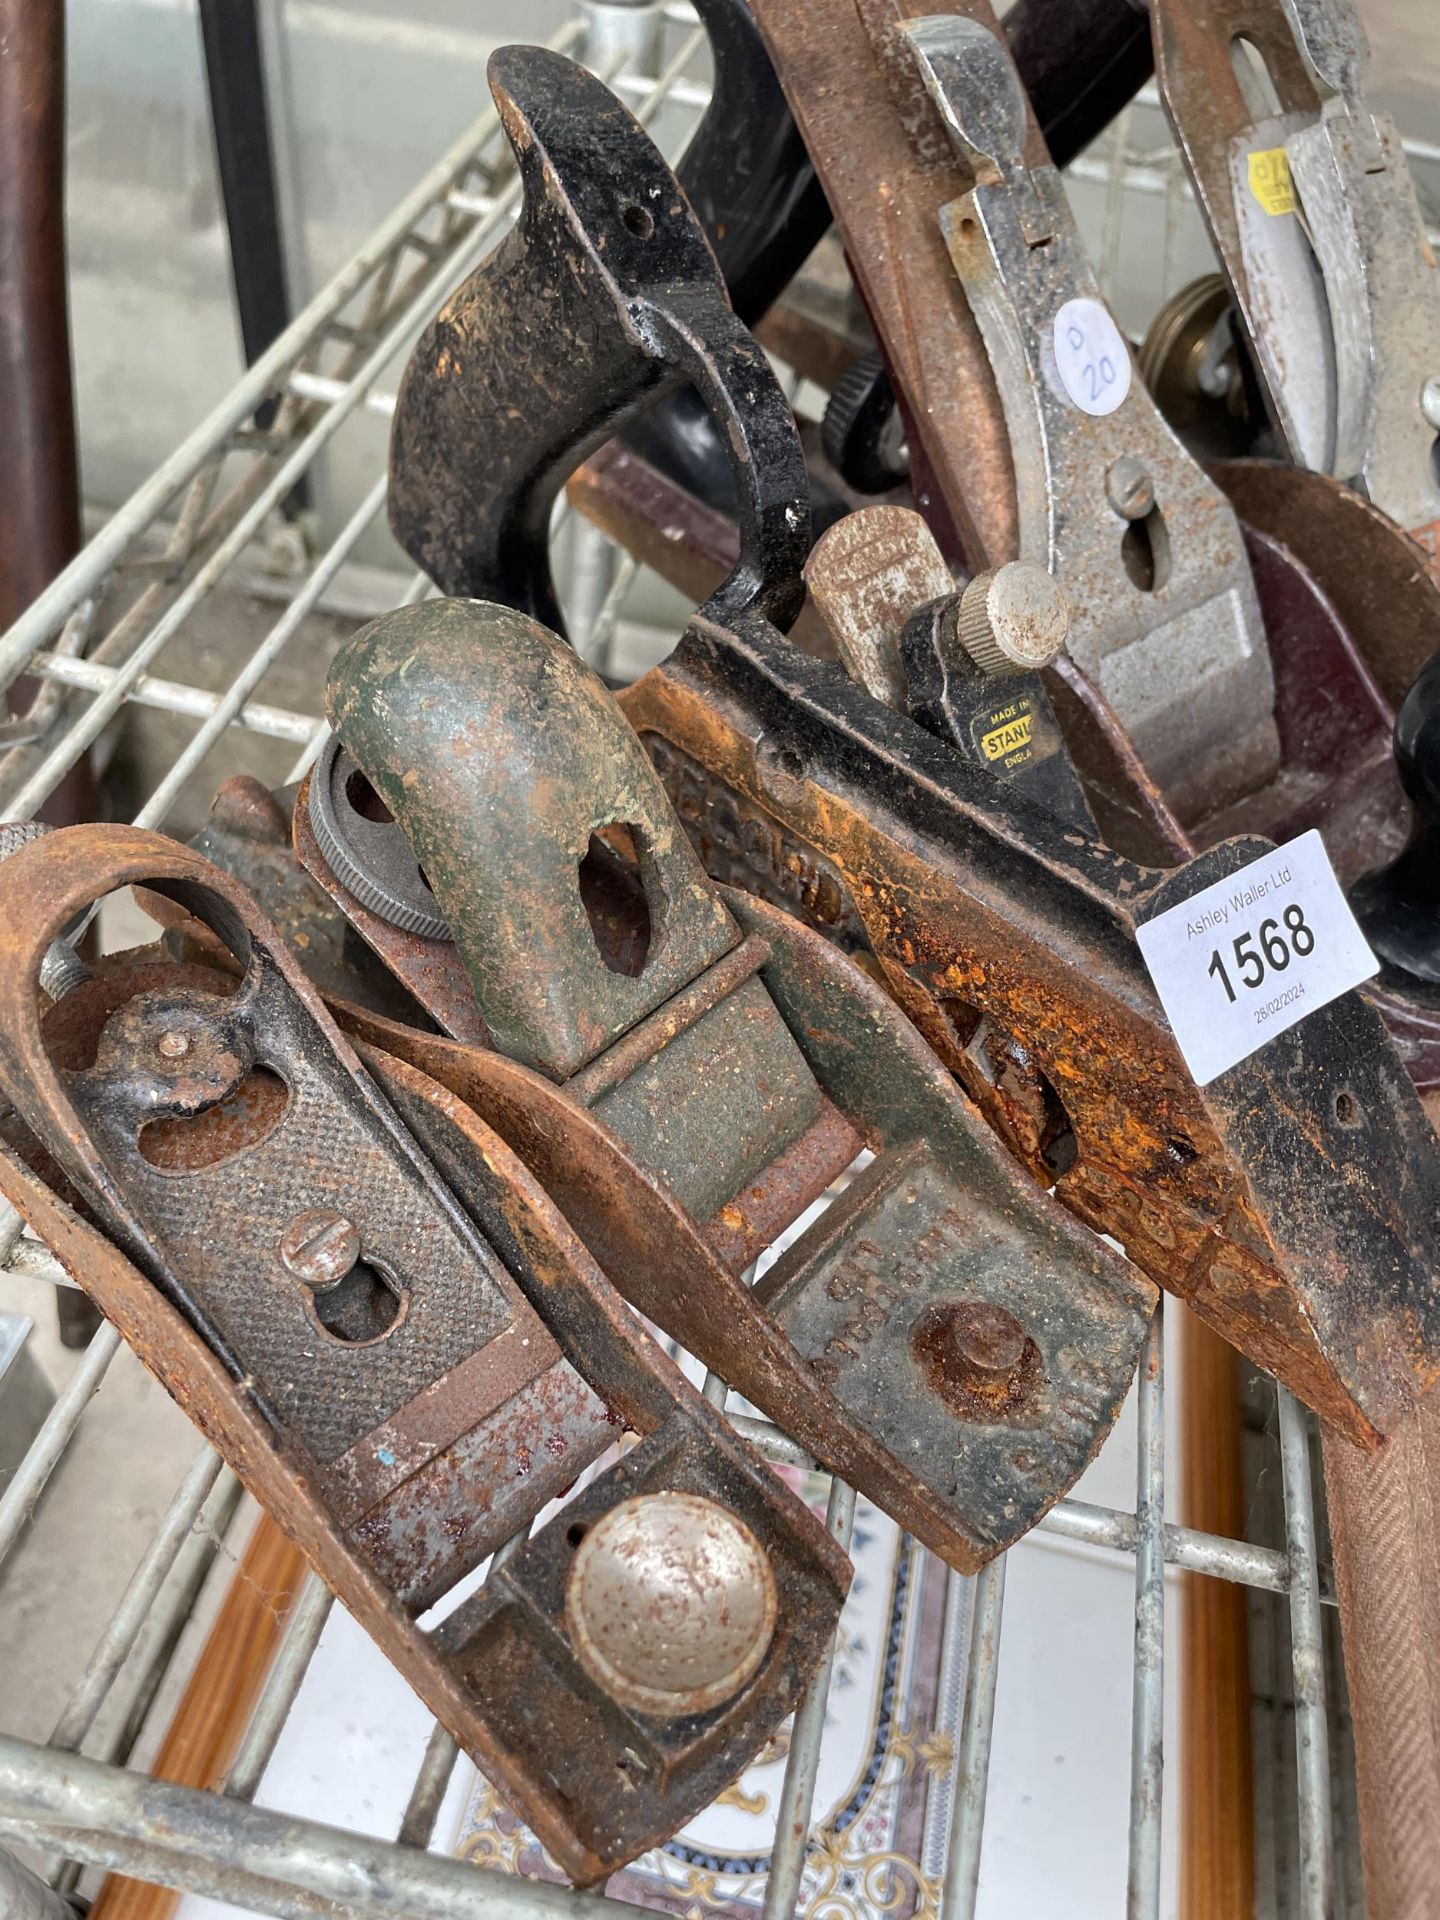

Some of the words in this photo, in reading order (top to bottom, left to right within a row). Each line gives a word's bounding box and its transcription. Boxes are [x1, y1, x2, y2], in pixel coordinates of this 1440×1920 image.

[1082, 355, 1117, 402] 20
[990, 704, 1017, 725] MADE
[987, 721, 1031, 754] STANL
[1004, 749, 1031, 769] ENGLA
[1185, 902, 1230, 941] Ashley
[1228, 879, 1272, 914] Waller
[1270, 865, 1293, 888] Ltd
[1207, 902, 1315, 1004] 1568
[1253, 981, 1306, 1024] 28/02/2024
